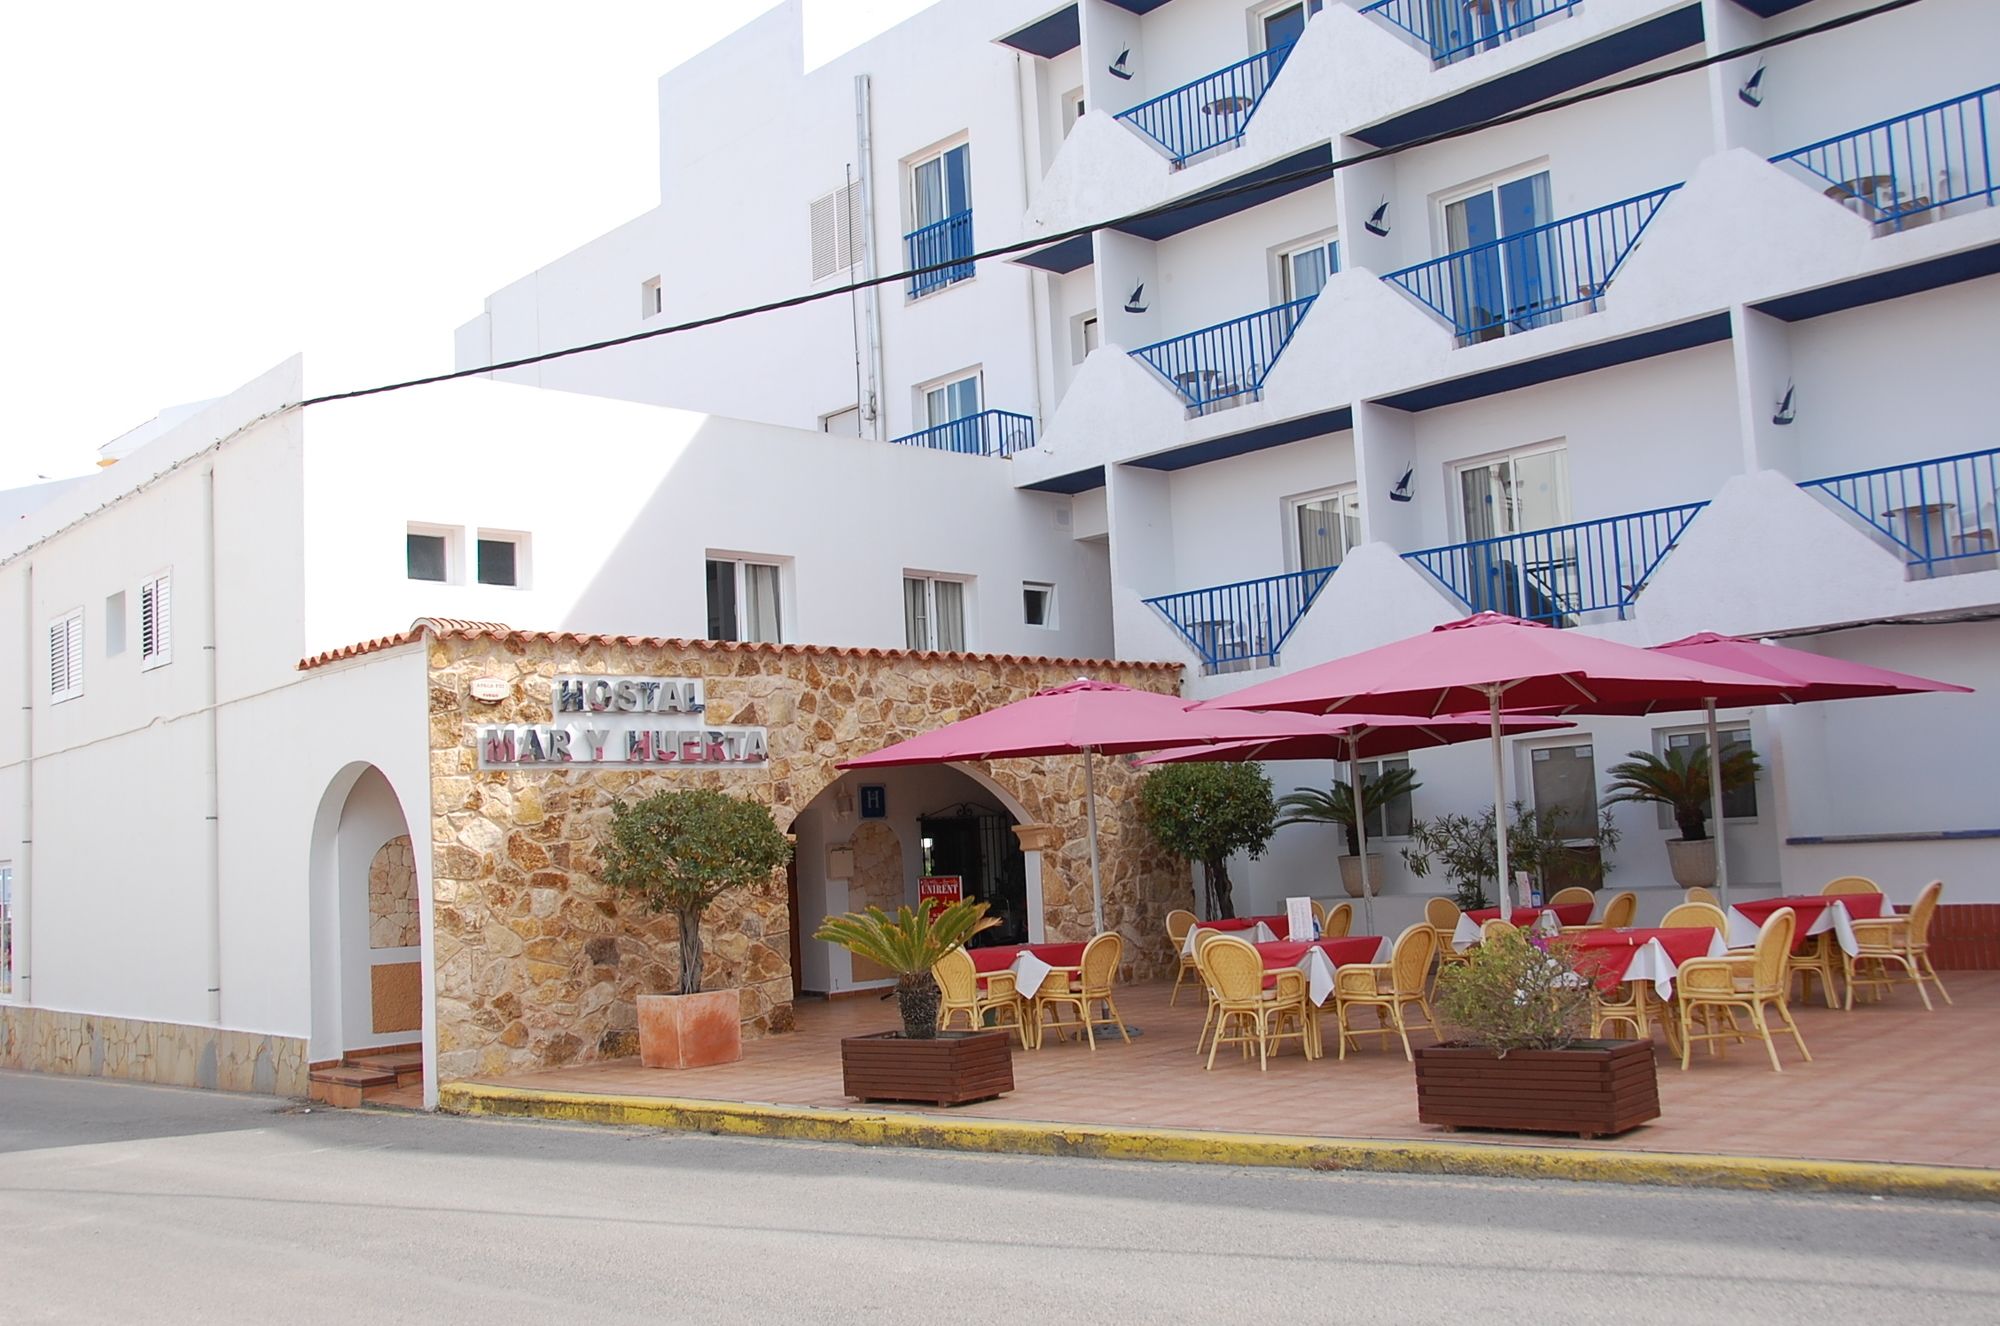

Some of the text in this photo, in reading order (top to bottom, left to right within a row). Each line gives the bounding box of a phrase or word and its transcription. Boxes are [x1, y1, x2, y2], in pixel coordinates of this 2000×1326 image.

[558, 679, 705, 713] HOSTAL
[485, 729, 768, 762] MAR Y HUERTA
[867, 790, 879, 809] H
[921, 884, 958, 894] UNIRENT
